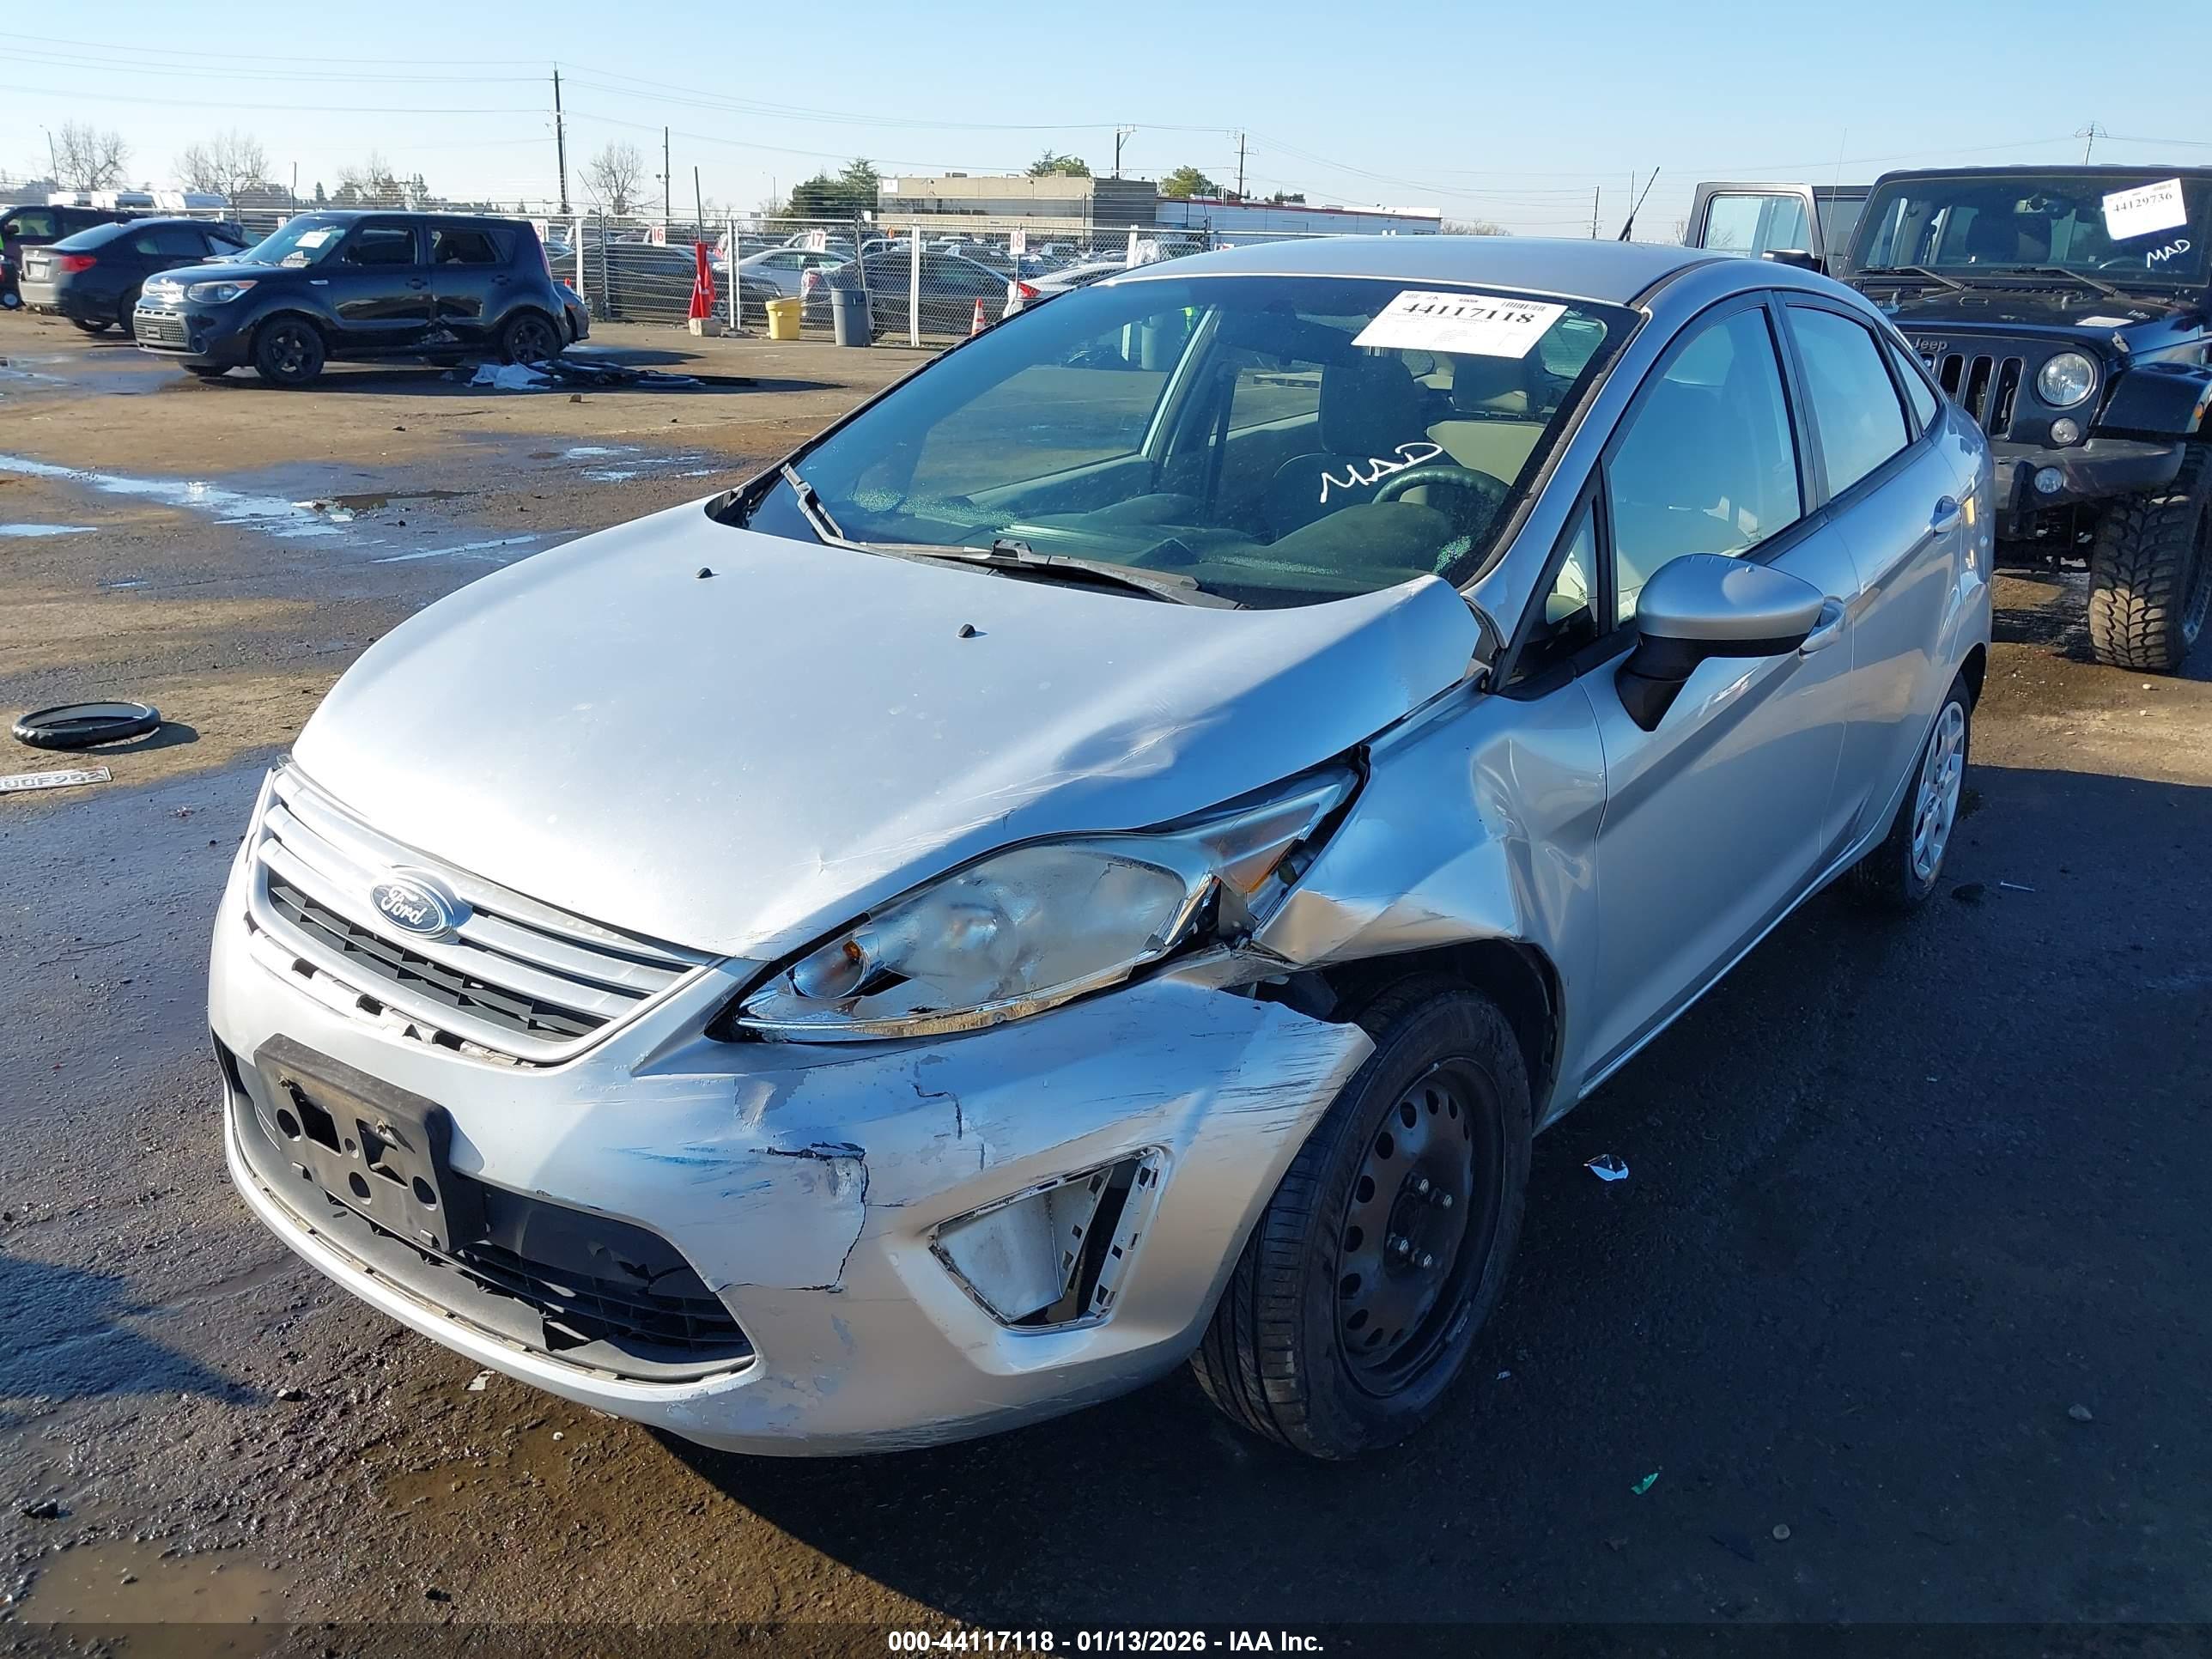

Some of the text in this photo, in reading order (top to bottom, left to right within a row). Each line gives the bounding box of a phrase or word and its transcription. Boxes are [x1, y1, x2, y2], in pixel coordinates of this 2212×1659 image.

[2113, 191, 2172, 212] 44129736
[653, 228, 664, 242] 16
[811, 232, 823, 246] 17
[1012, 232, 1023, 247] 18
[2146, 239, 2191, 268] MAD
[1401, 302, 1535, 325] 44117118
[1915, 337, 1948, 353] Jeep
[1319, 441, 1443, 504] MAD
[380, 885, 428, 926] Ford
